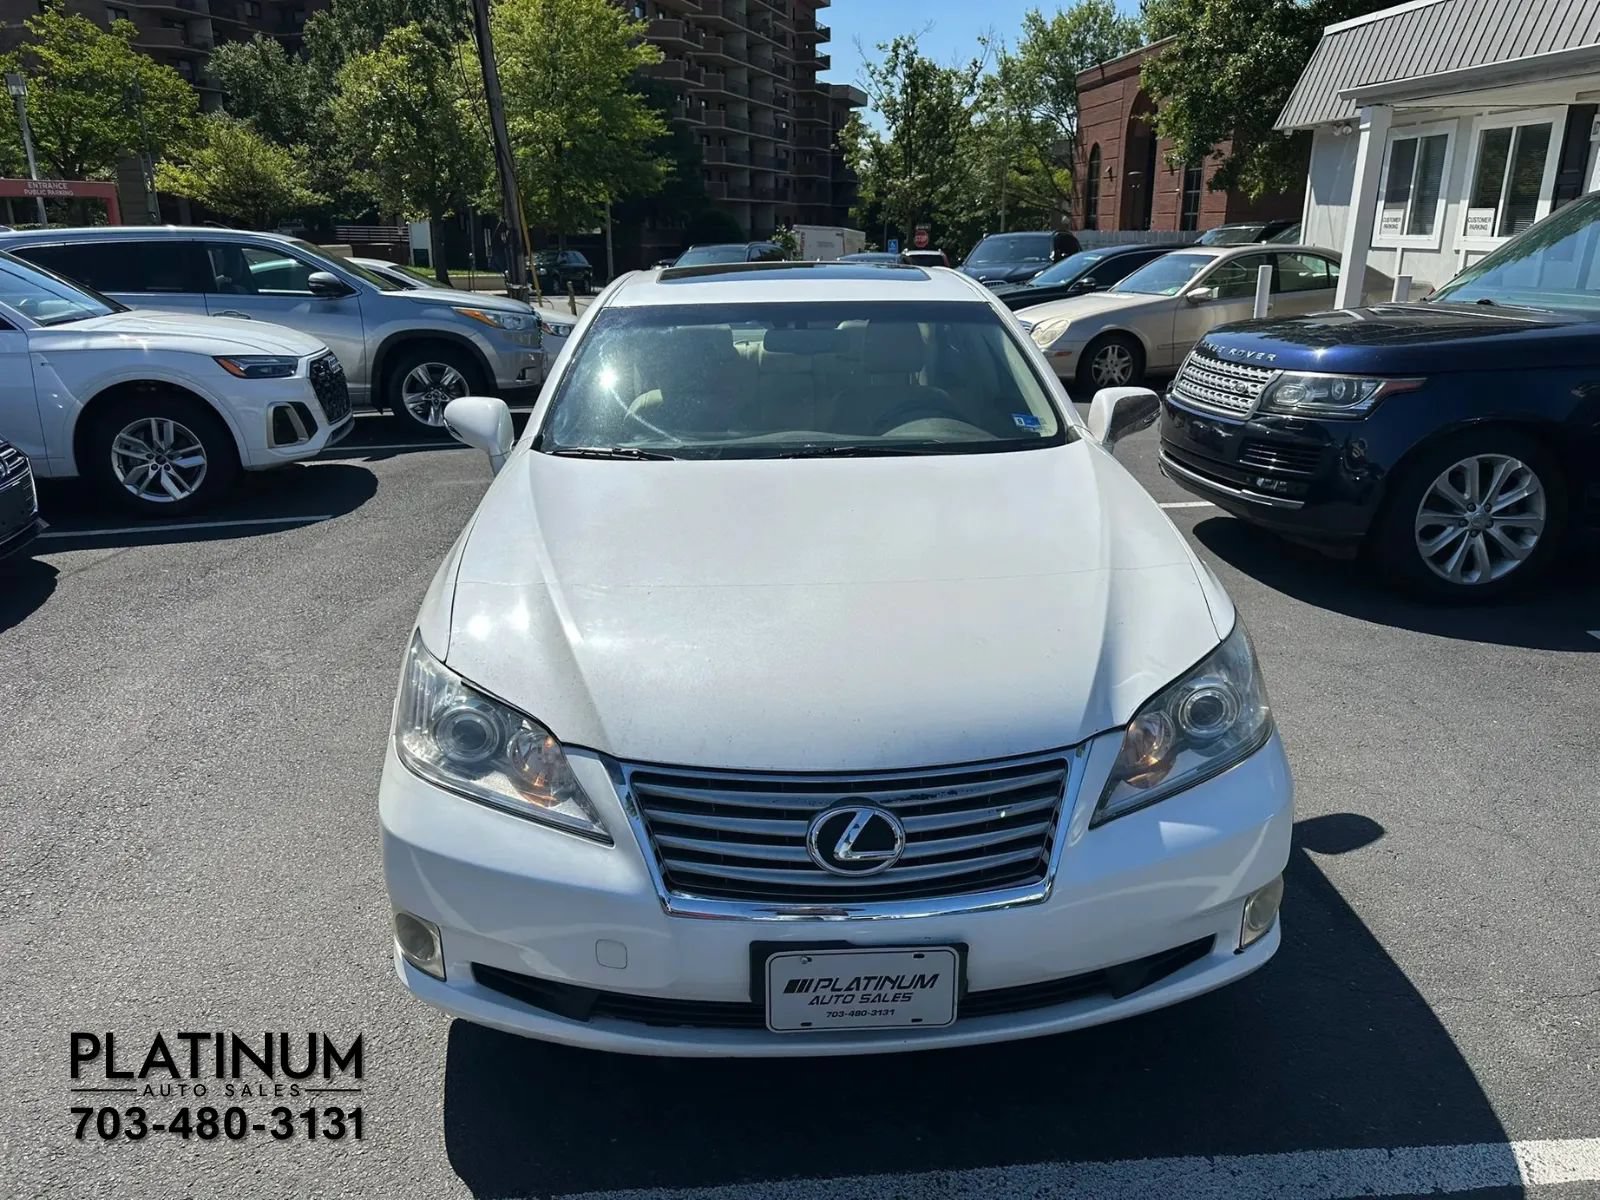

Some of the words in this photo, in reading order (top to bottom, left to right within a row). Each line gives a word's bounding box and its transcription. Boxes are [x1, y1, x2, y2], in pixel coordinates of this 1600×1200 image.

[1469, 223, 1488, 231] PARKING
[1228, 348, 1277, 361] ROVER
[813, 973, 940, 993] PLATINUM
[808, 994, 855, 1006] AUTO
[858, 991, 914, 1004] SALES
[825, 1008, 895, 1018] 703-480-3131
